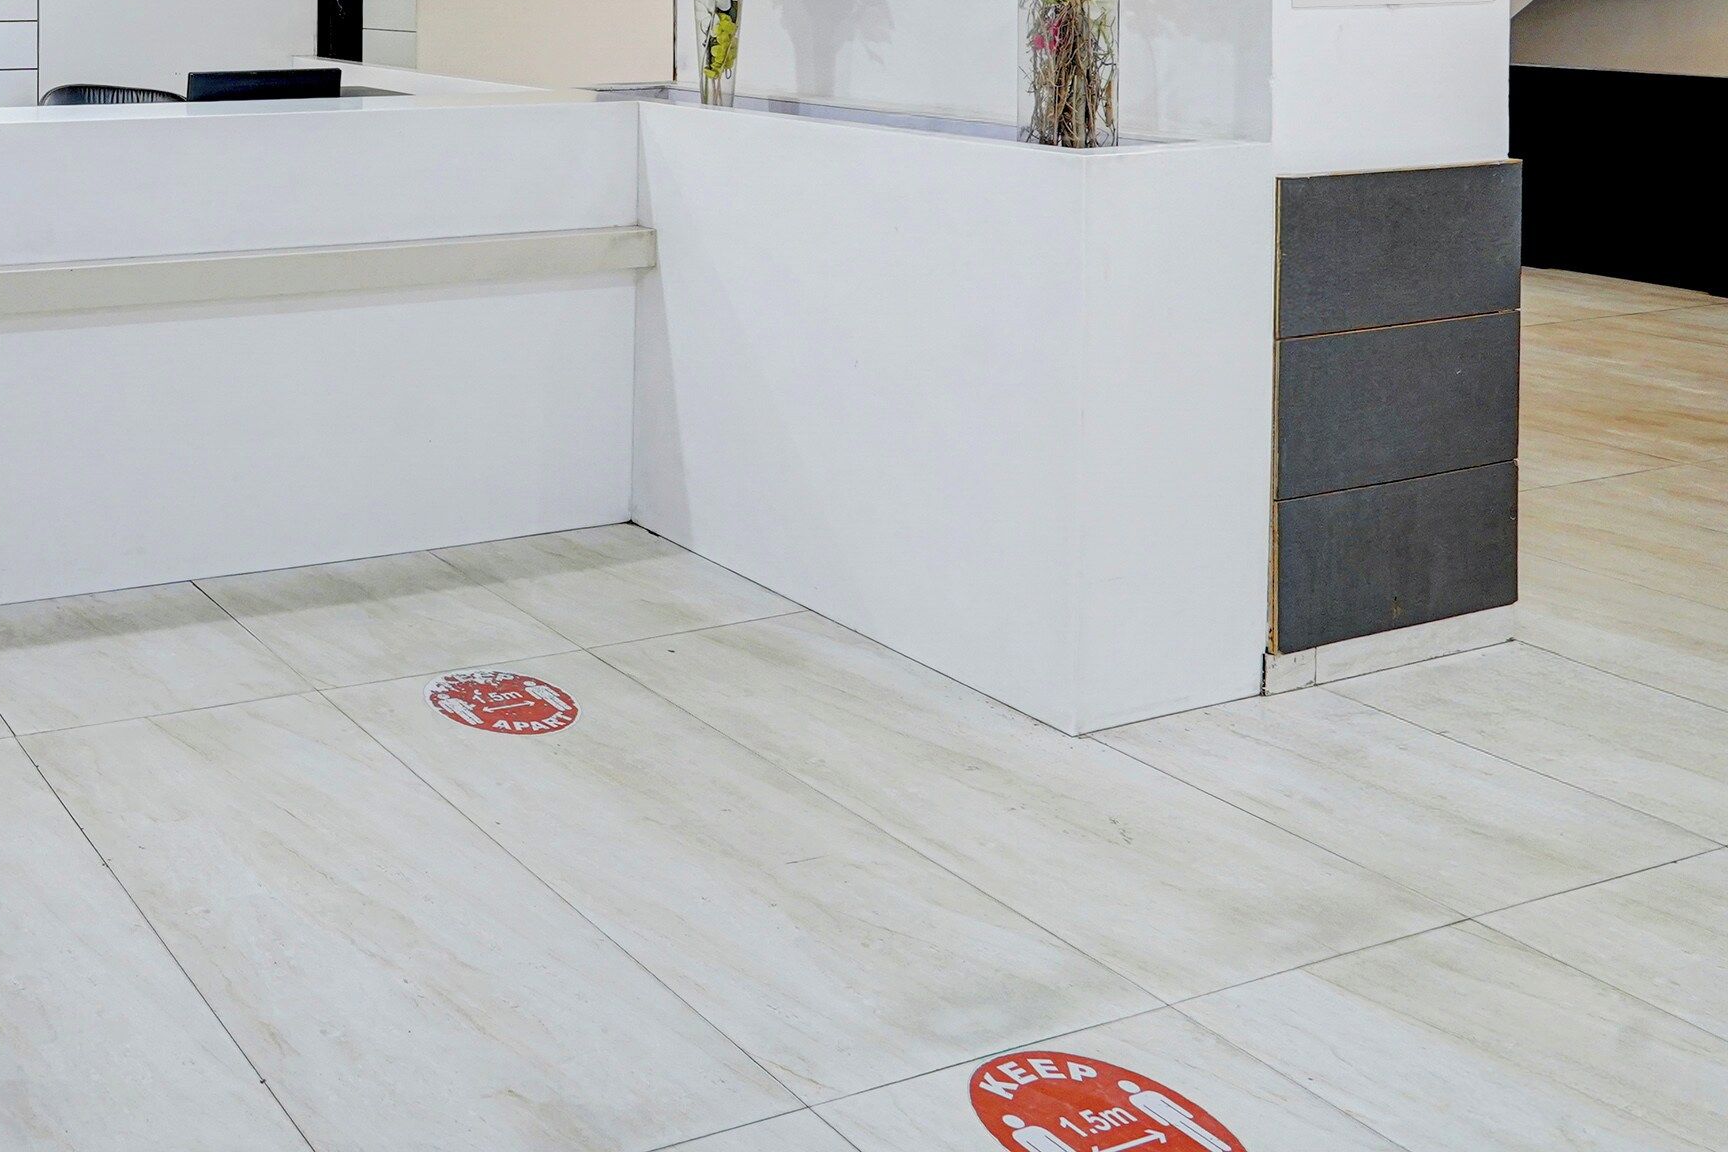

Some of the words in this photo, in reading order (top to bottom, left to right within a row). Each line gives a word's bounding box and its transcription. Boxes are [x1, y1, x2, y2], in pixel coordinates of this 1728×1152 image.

[492, 711, 572, 731] APART
[979, 1058, 1098, 1100] KEEP
[1059, 1104, 1138, 1138] 1.5m
